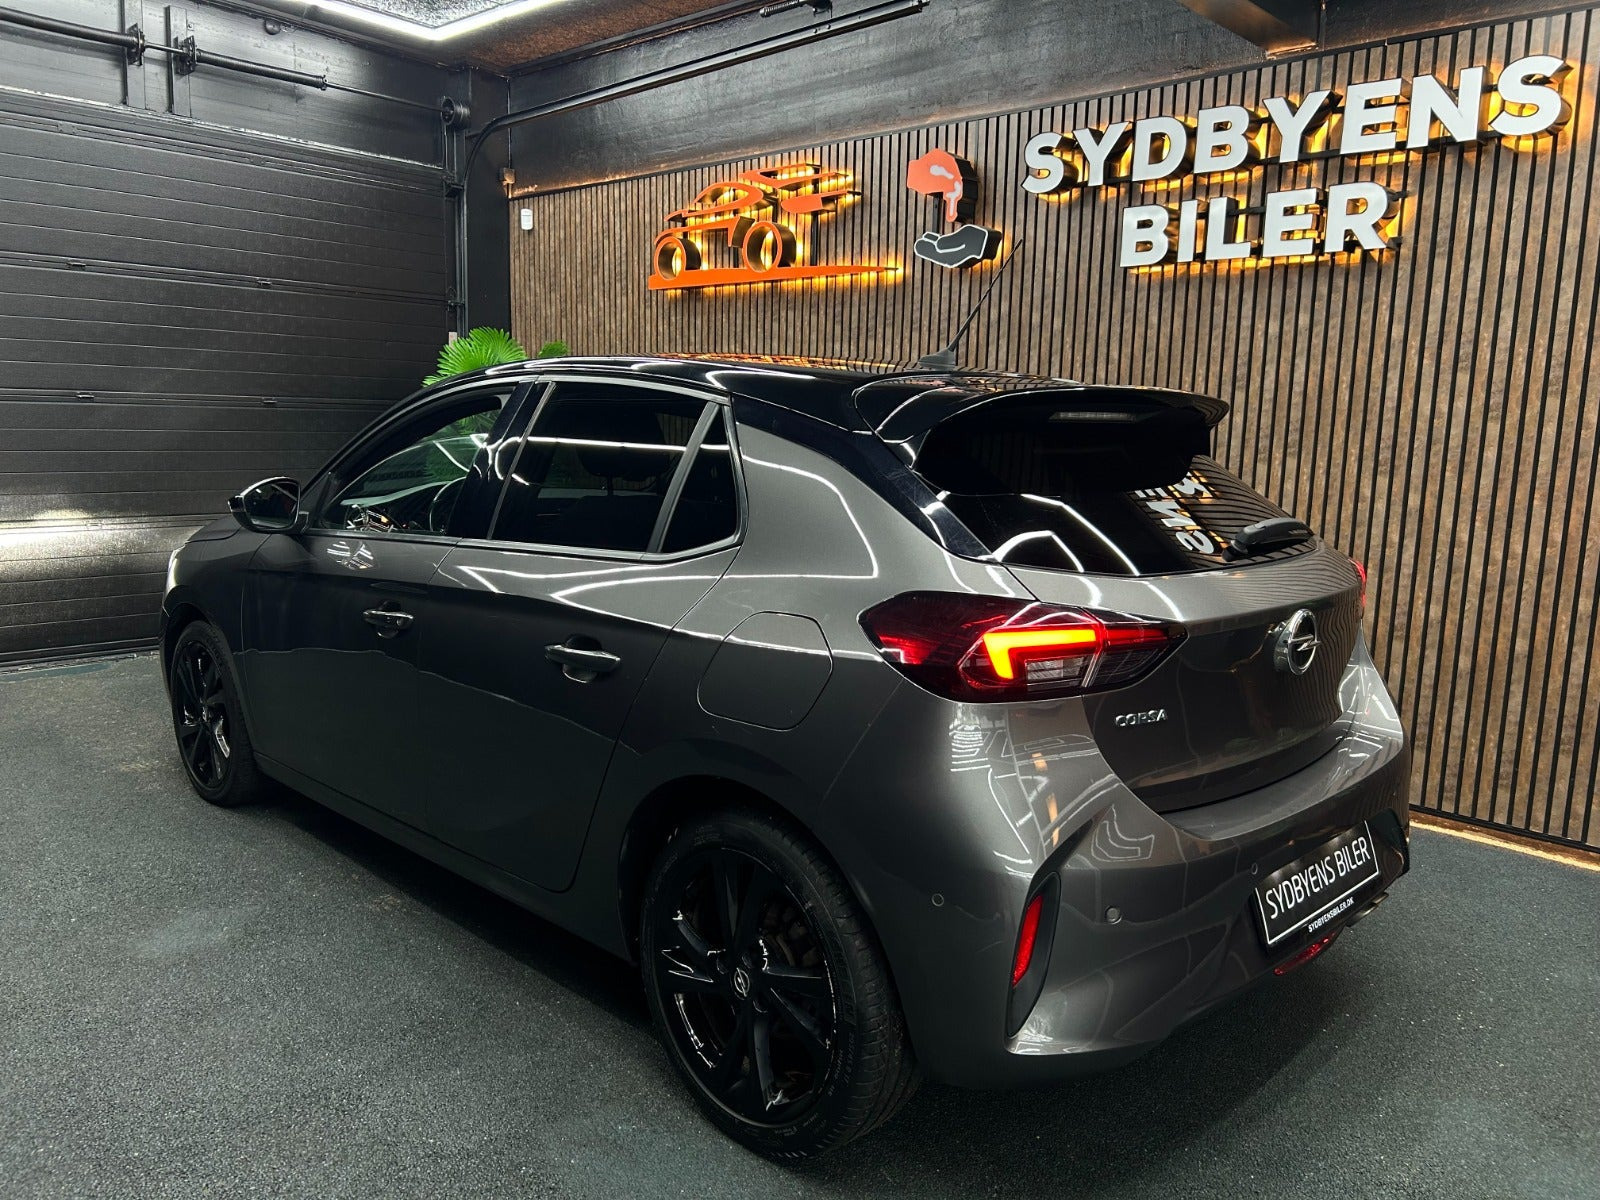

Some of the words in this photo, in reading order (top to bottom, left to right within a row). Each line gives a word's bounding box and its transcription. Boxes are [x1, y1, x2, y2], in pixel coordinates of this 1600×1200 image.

[1021, 54, 1566, 196] SYDBYENS
[1119, 182, 1390, 270] BILER
[1115, 709, 1166, 727] CORSA
[1265, 856, 1337, 920] SYDBYENS
[1333, 836, 1371, 877] BILER
